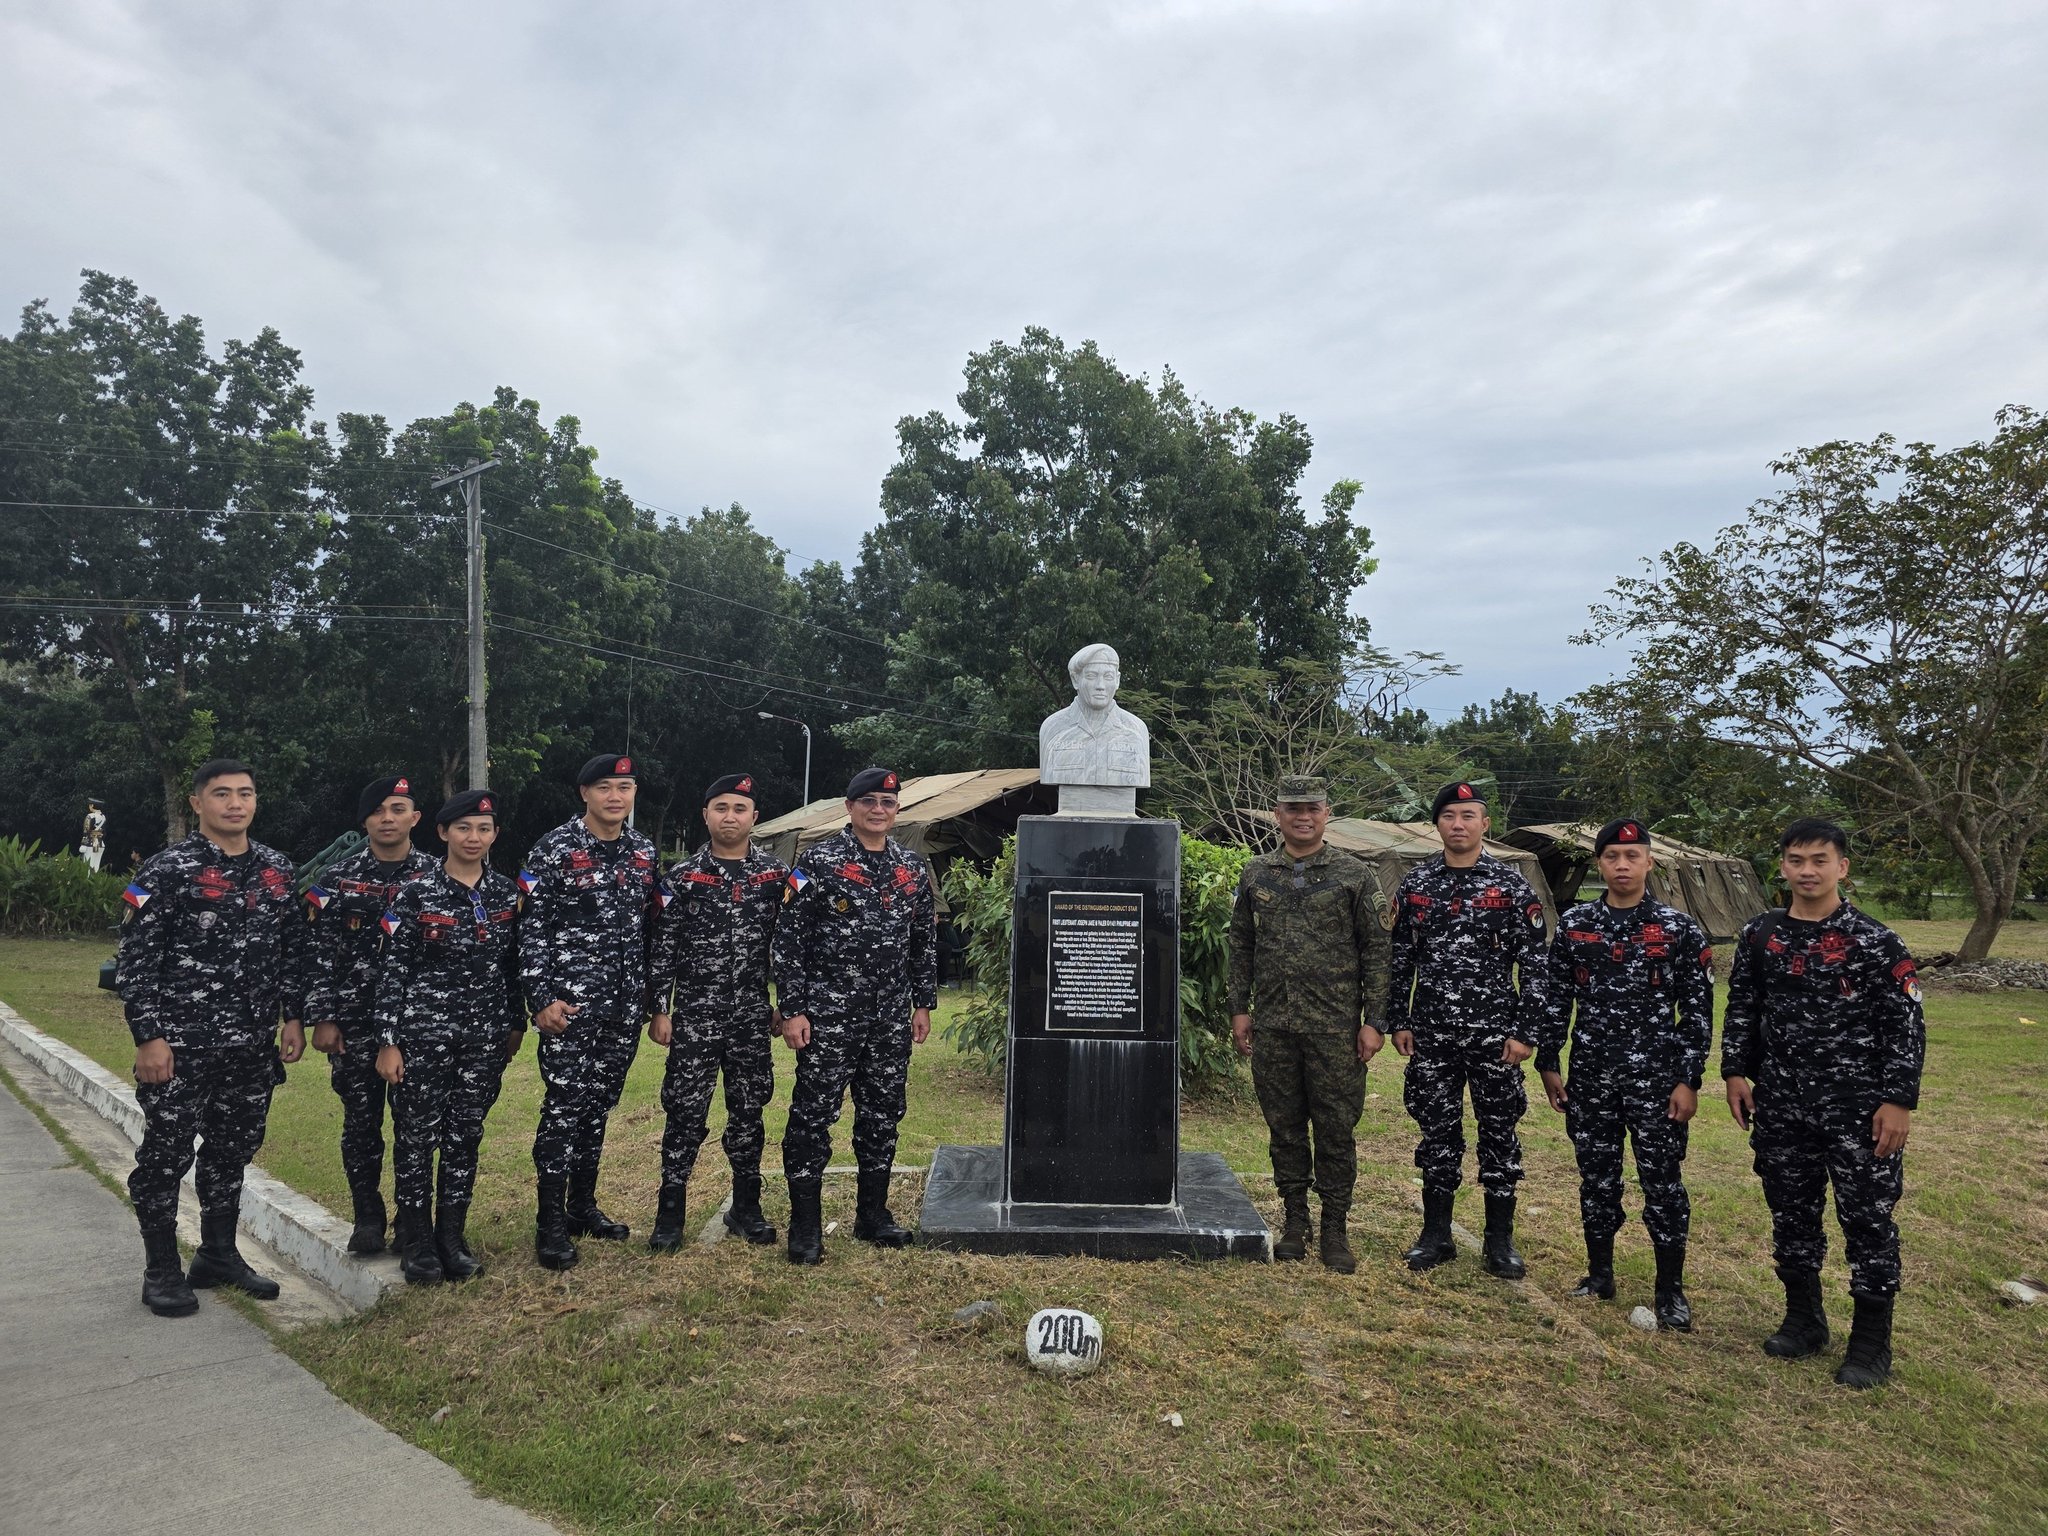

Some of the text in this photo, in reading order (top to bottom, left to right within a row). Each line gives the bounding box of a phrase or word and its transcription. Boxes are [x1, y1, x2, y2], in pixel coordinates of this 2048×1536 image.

[690, 873, 715, 883] QUINTO
[756, 872, 778, 882] ARMY
[1038, 1314, 1100, 1360] 200m
